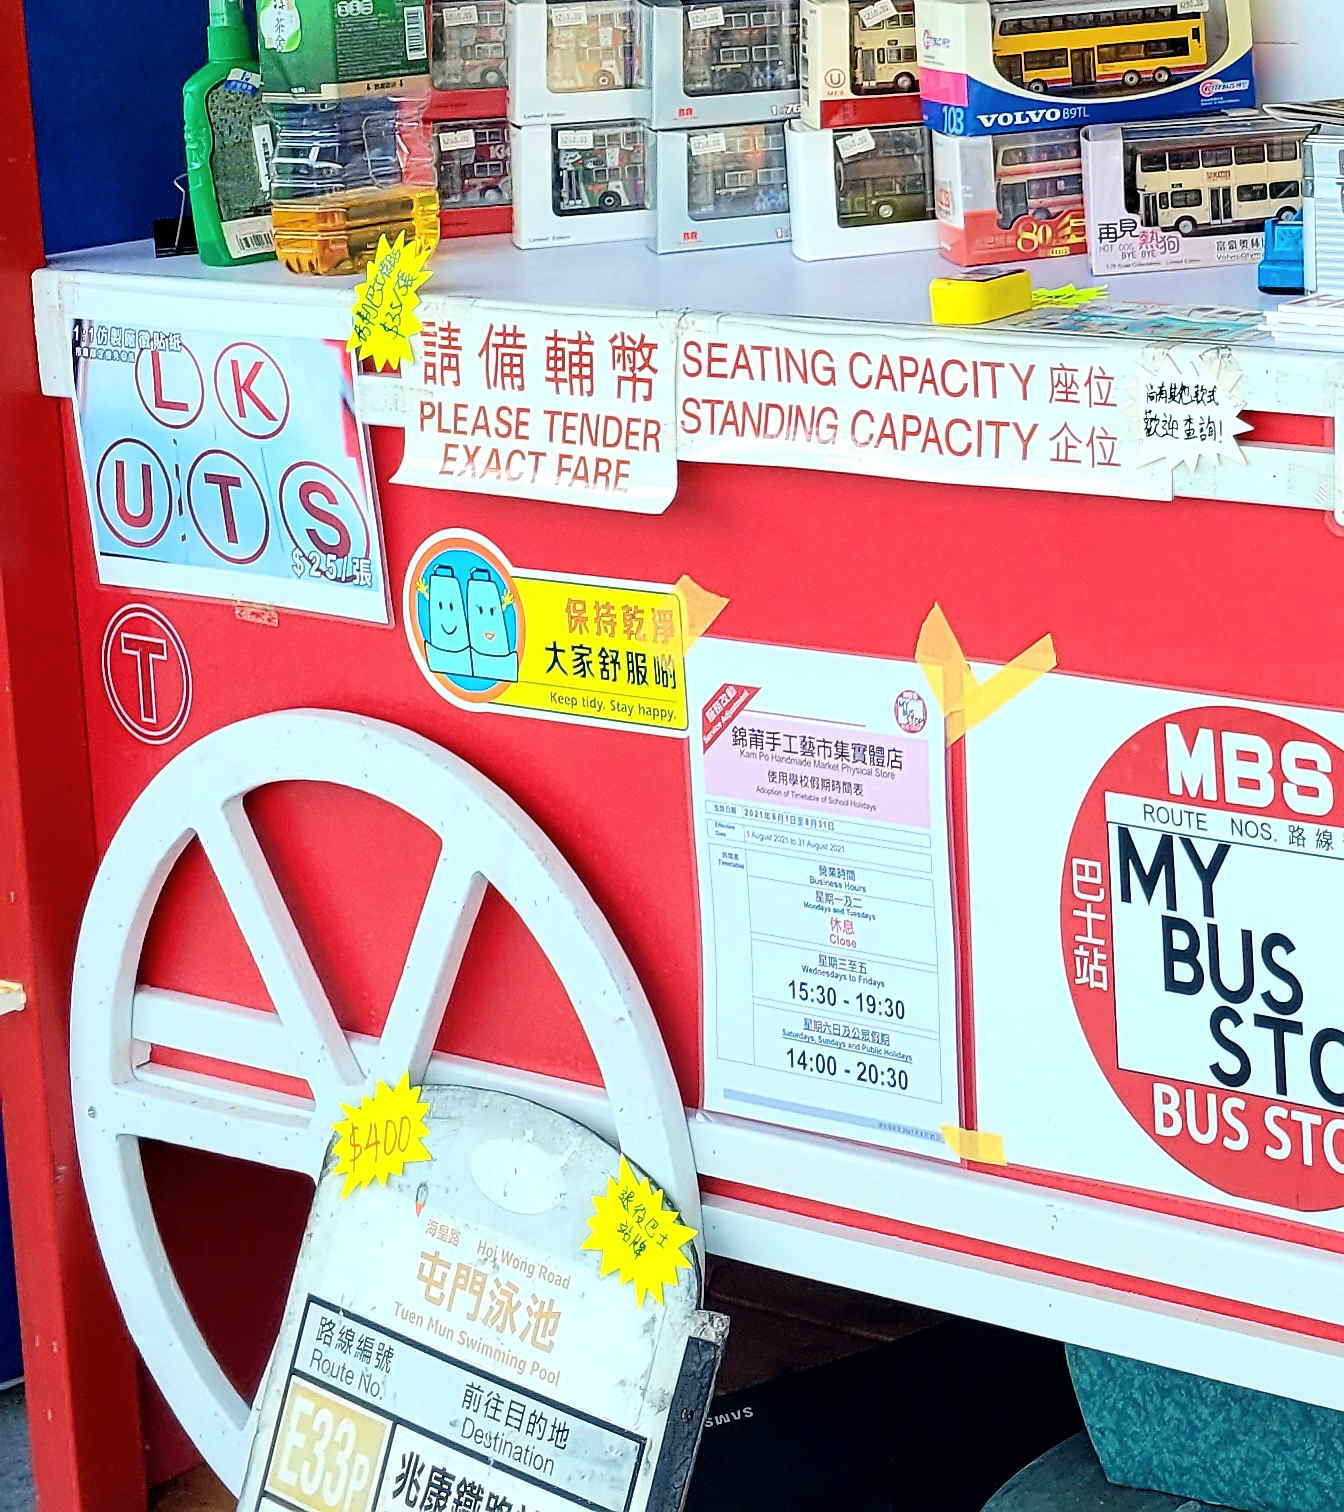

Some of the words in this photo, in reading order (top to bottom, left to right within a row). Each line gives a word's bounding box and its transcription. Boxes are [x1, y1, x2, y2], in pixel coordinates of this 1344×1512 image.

[942, 105, 964, 135] 103
[976, 108, 1061, 127] VOLVO
[1063, 106, 1090, 120] B9TL
[151, 350, 189, 412] L
[231, 359, 278, 422] K
[420, 320, 659, 404] 請備輔幣
[682, 339, 837, 387] SEATING
[847, 348, 1036, 403] CAPACITY
[1047, 361, 1119, 409] 座位
[419, 400, 531, 441] PLEASE
[543, 409, 662, 453] TENDER
[680, 396, 839, 447] STANDING
[849, 408, 1040, 462] CAPACITY
[1048, 421, 1122, 469] 企位
[439, 444, 547, 486] EXACT
[556, 454, 631, 494] FARE
[115, 460, 152, 528] U
[204, 473, 242, 544] T
[299, 481, 352, 558] S
[120, 632, 168, 725] T
[550, 692, 578, 711] Keep
[609, 698, 637, 717] Stay
[638, 702, 678, 723] happy.
[739, 749, 757, 761] Kam
[771, 754, 812, 769] Handmade
[814, 759, 839, 773] Market
[841, 763, 873, 778] Physical
[875, 767, 896, 780] Store
[1165, 722, 1335, 817] MBS
[1143, 803, 1209, 832] ROUTE
[1230, 818, 1279, 844] NOS.
[1117, 825, 1231, 919] MY
[829, 916, 855, 935] 休息
[829, 934, 857, 949] Close
[1071, 857, 1108, 991] 巴士站
[857, 973, 886, 989] Fridays
[1161, 914, 1304, 1016] BUS
[788, 978, 837, 1007] 15:30
[855, 992, 906, 1020] 19:30
[786, 1047, 837, 1077] 14:00
[856, 1060, 909, 1091] 20:30
[348, 1115, 413, 1175] $400
[1152, 1082, 1250, 1152] BUS
[500, 1250, 537, 1279] Wong
[538, 1263, 571, 1289] Road
[416, 1249, 561, 1355] 屯門泳池
[316, 1316, 395, 1374] 路線編號
[393, 1300, 424, 1328] Tuen
[427, 1315, 456, 1340] Mun
[458, 1329, 527, 1373] Swimming
[529, 1357, 561, 1387] Pool
[309, 1347, 355, 1387] Route
[357, 1372, 385, 1402] No.
[461, 1381, 571, 1451] 前往目的地
[460, 1417, 556, 1476] Destination
